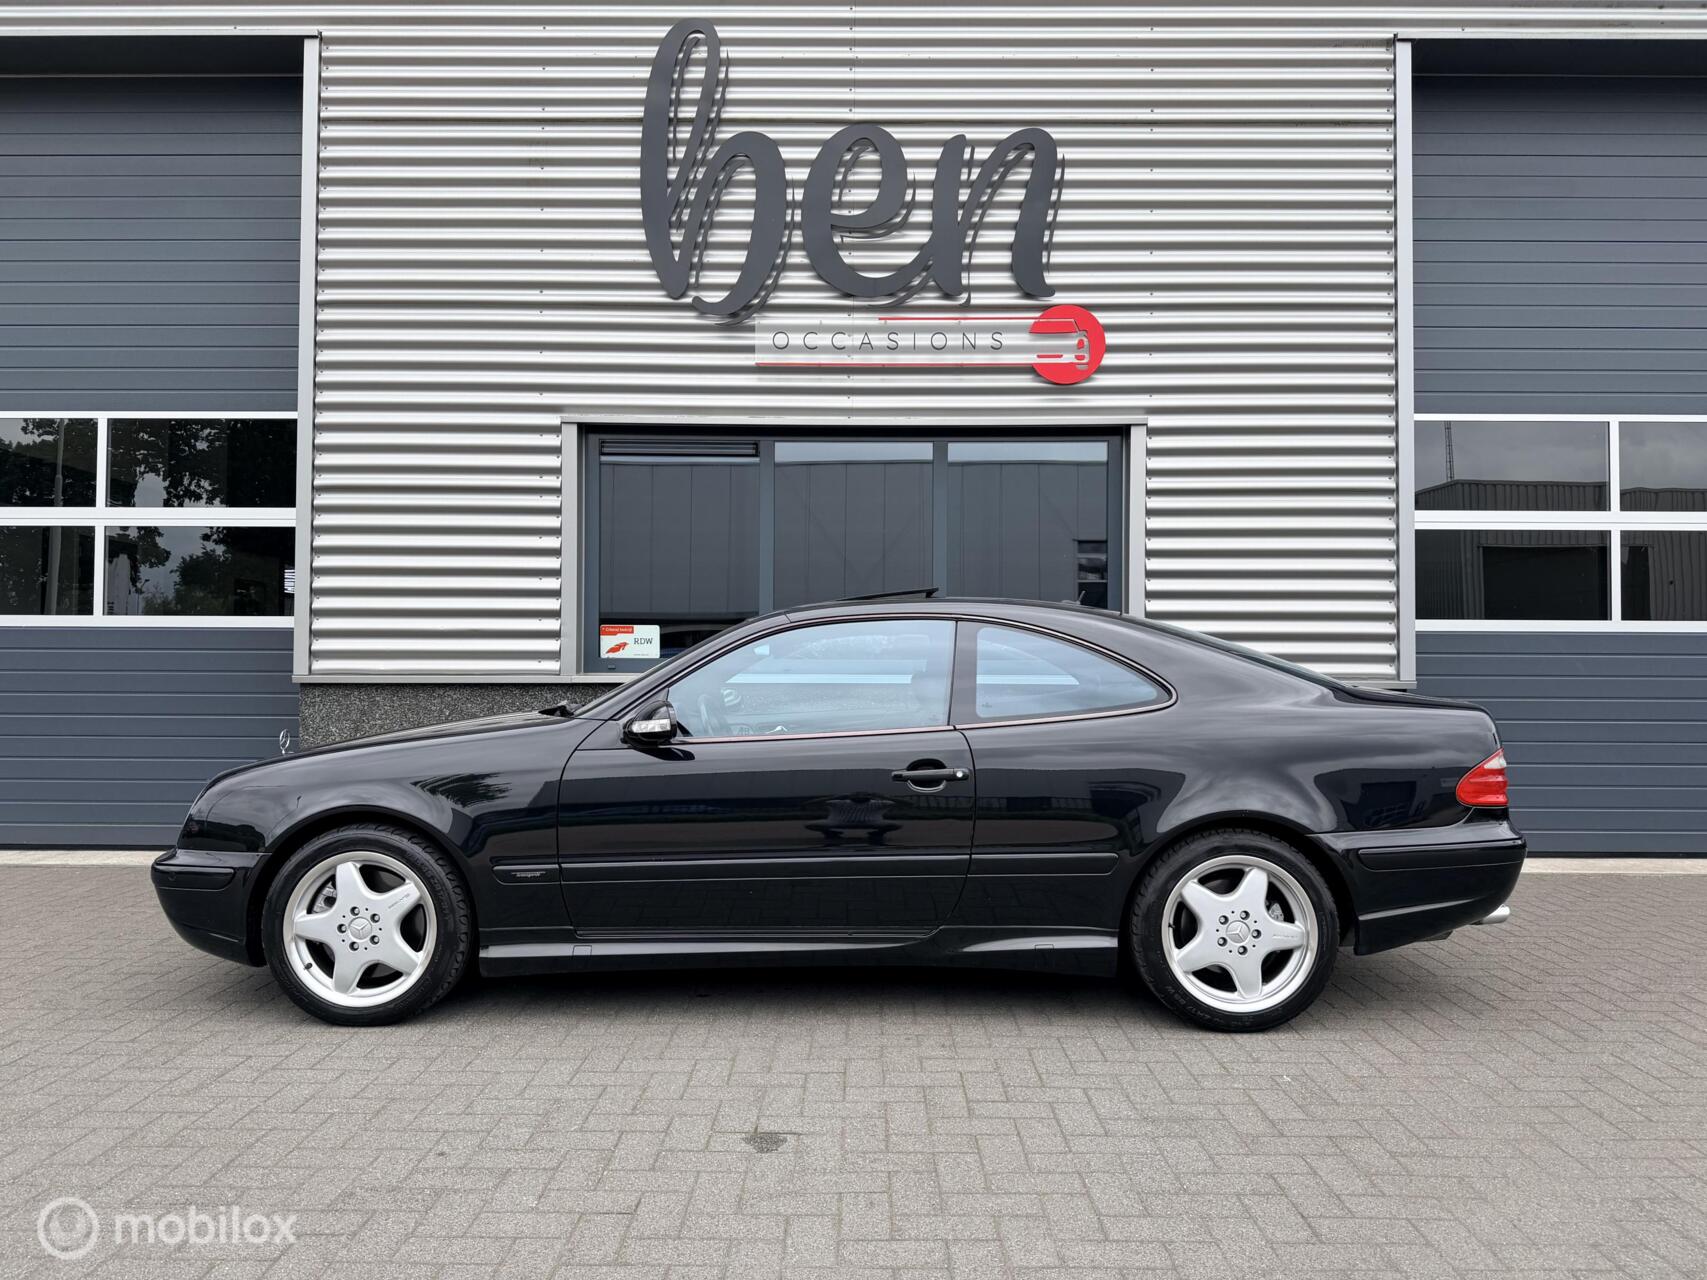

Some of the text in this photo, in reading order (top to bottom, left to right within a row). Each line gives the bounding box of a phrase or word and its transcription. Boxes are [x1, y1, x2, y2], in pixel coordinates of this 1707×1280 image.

[640, 18, 1057, 316] ben
[771, 331, 1005, 351] OCCASIONS
[633, 637, 653, 645] RDW
